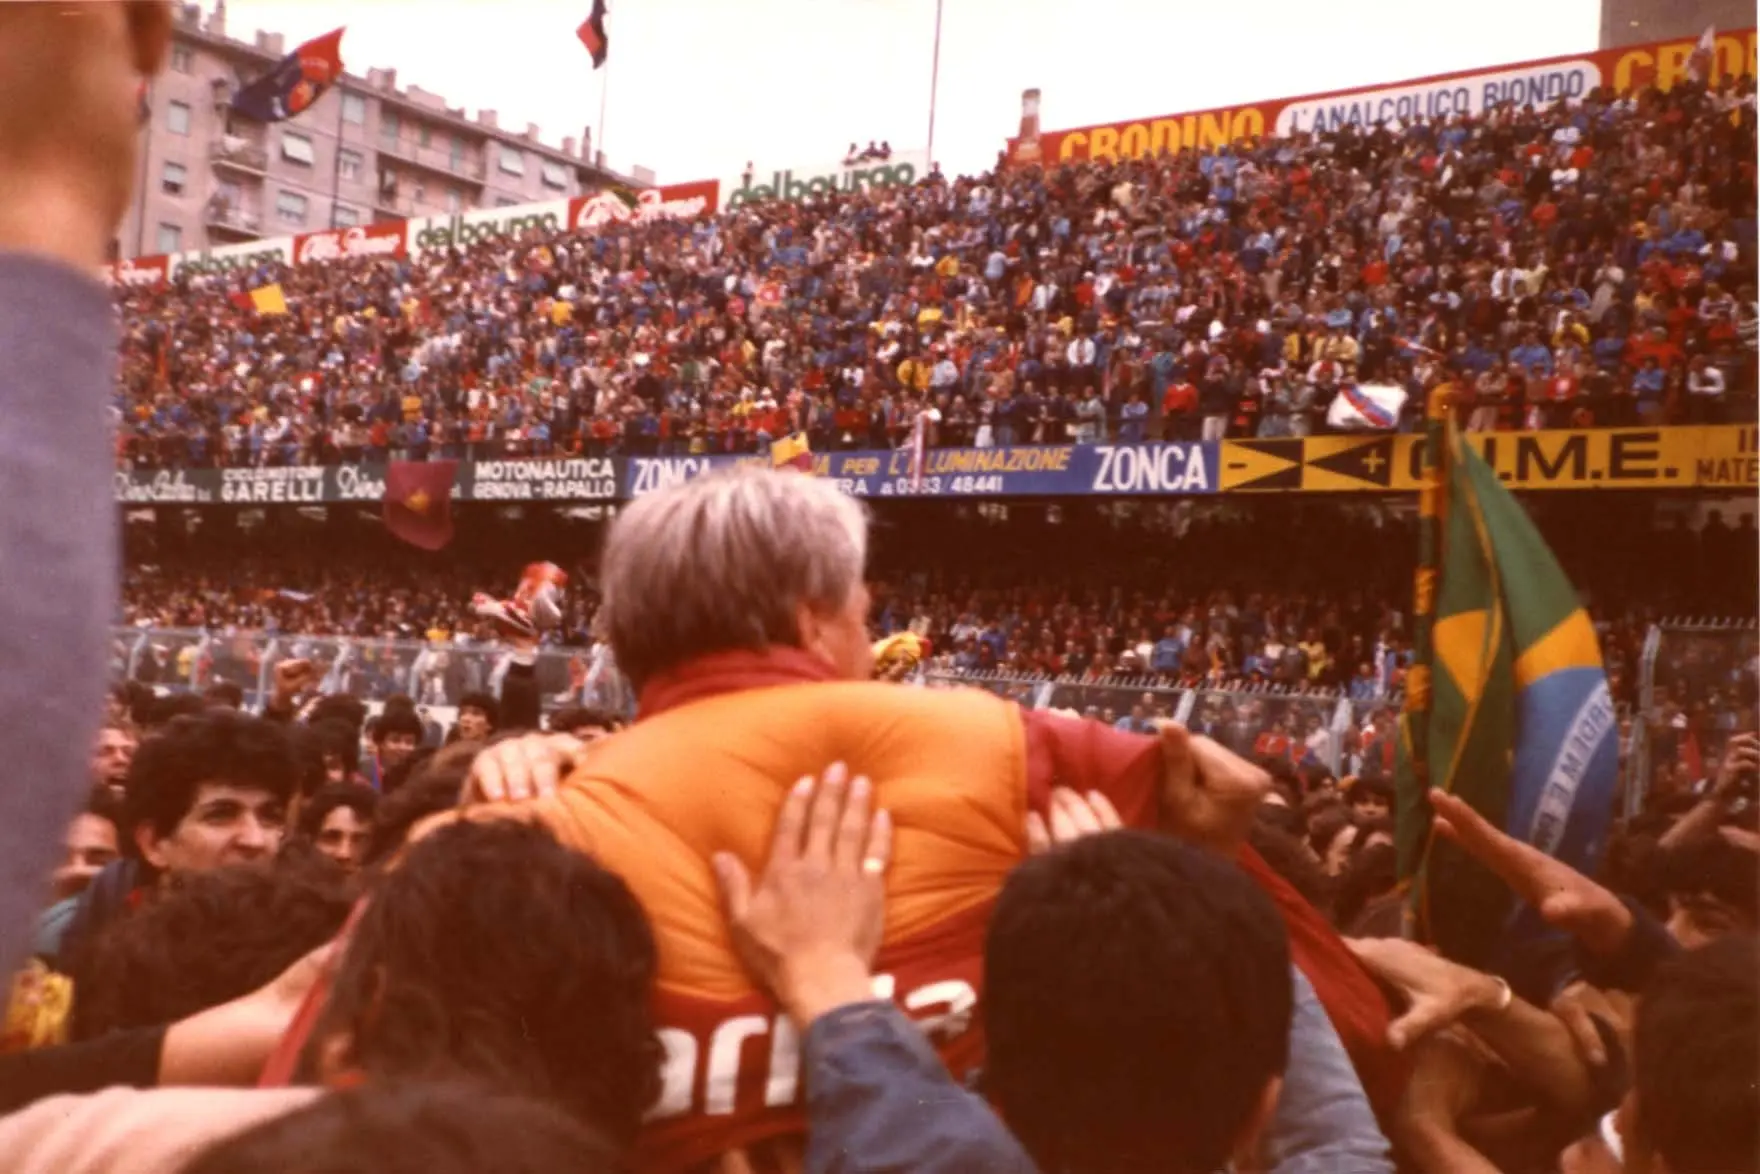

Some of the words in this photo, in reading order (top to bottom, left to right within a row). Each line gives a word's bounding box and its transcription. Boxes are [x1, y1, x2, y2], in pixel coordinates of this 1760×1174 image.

[1291, 87, 1470, 133] L'ANALCOLICO
[1483, 69, 1584, 112] BIONDO
[1059, 108, 1264, 166] CRODINO
[474, 458, 615, 481] MOTONAUTICA
[841, 456, 881, 475] PER
[888, 448, 1072, 475] L'ILUMINAZIONE
[1093, 445, 1208, 493] ZONCA
[221, 480, 325, 502] GARELLI
[472, 480, 533, 499] GENOVA
[543, 480, 616, 498] RAPALLO
